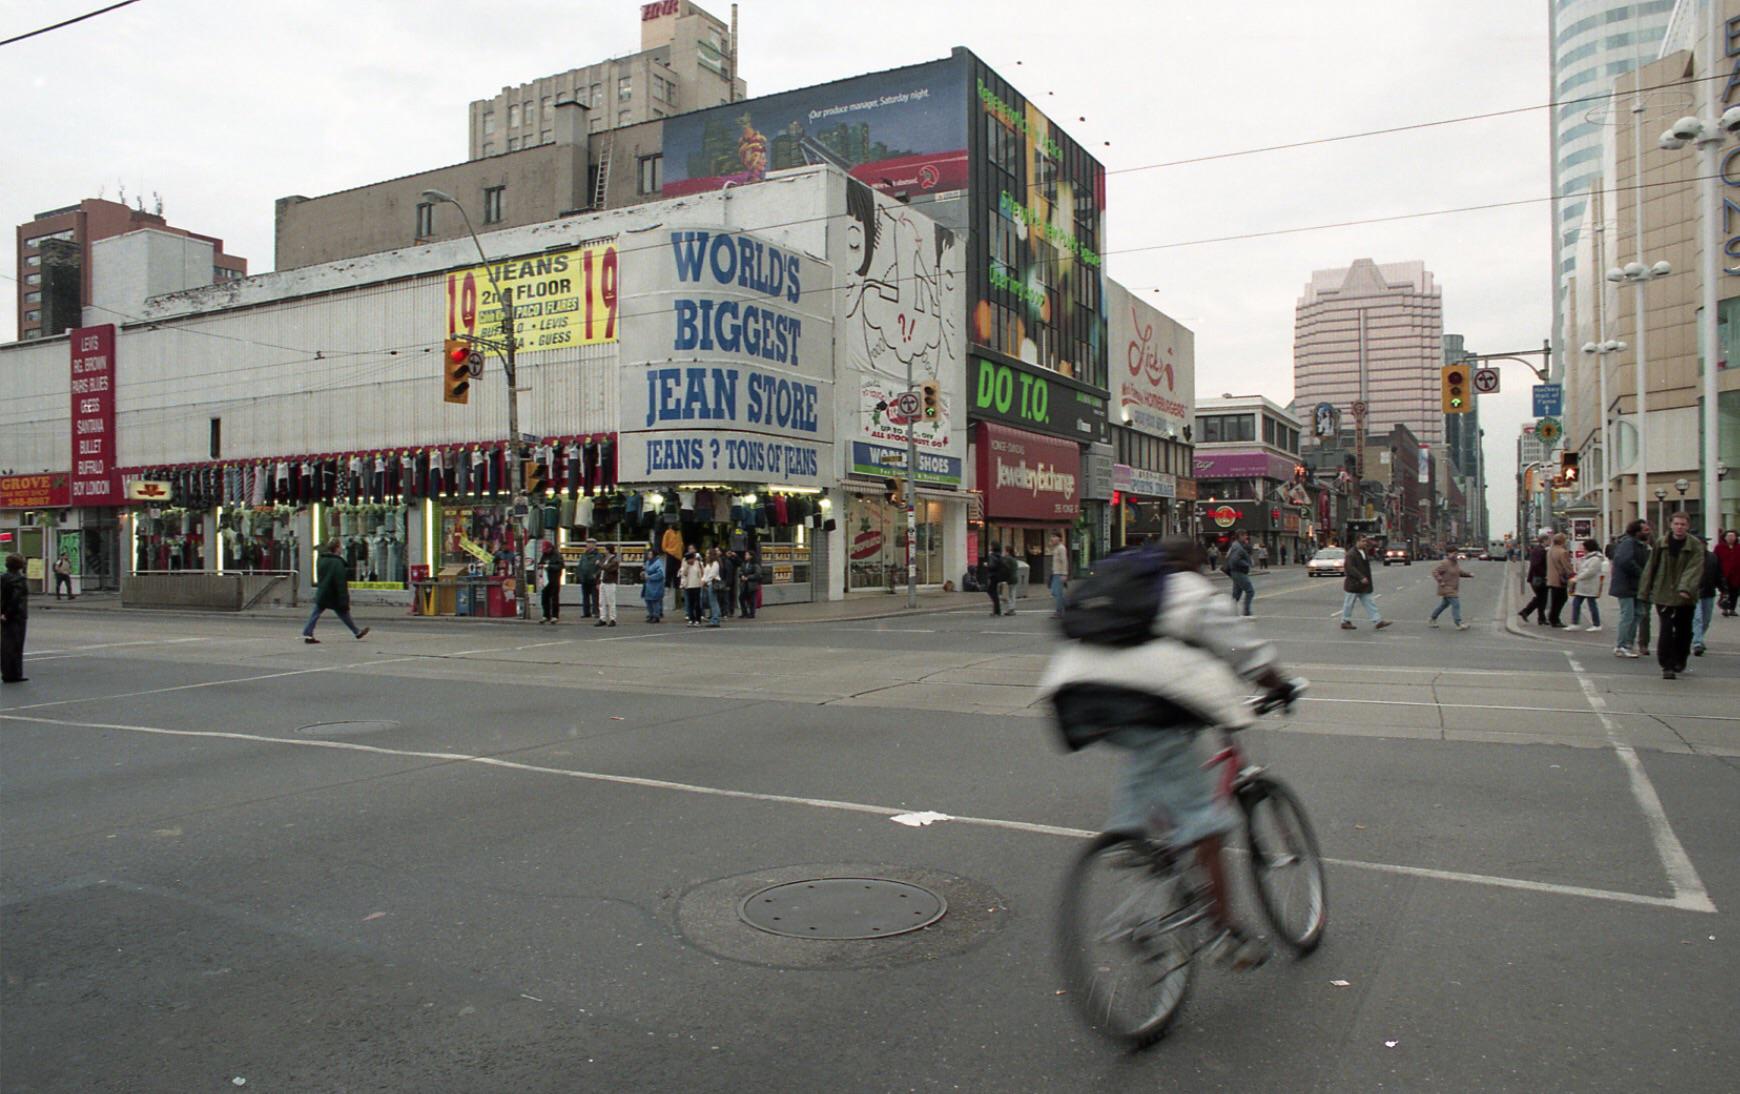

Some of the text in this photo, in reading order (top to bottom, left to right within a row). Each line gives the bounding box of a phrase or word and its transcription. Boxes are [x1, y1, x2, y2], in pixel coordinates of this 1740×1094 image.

[823, 105, 848, 118] produce
[489, 255, 569, 284] JEANS
[671, 231, 800, 304] WORLD'S
[517, 278, 571, 300] FLOOR
[538, 331, 571, 347] GUESS
[674, 299, 800, 366] BIGGEST
[646, 367, 817, 432] JEAN STORE
[976, 360, 1013, 414] DO
[1020, 371, 1049, 424] T.O.
[871, 430, 885, 439] ALL
[646, 438, 703, 475] JEANS
[726, 439, 764, 472] TONS
[767, 444, 783, 474] OF
[784, 446, 817, 479] JEANS
[919, 455, 950, 474] SHOES
[2, 475, 50, 490] GROVE
